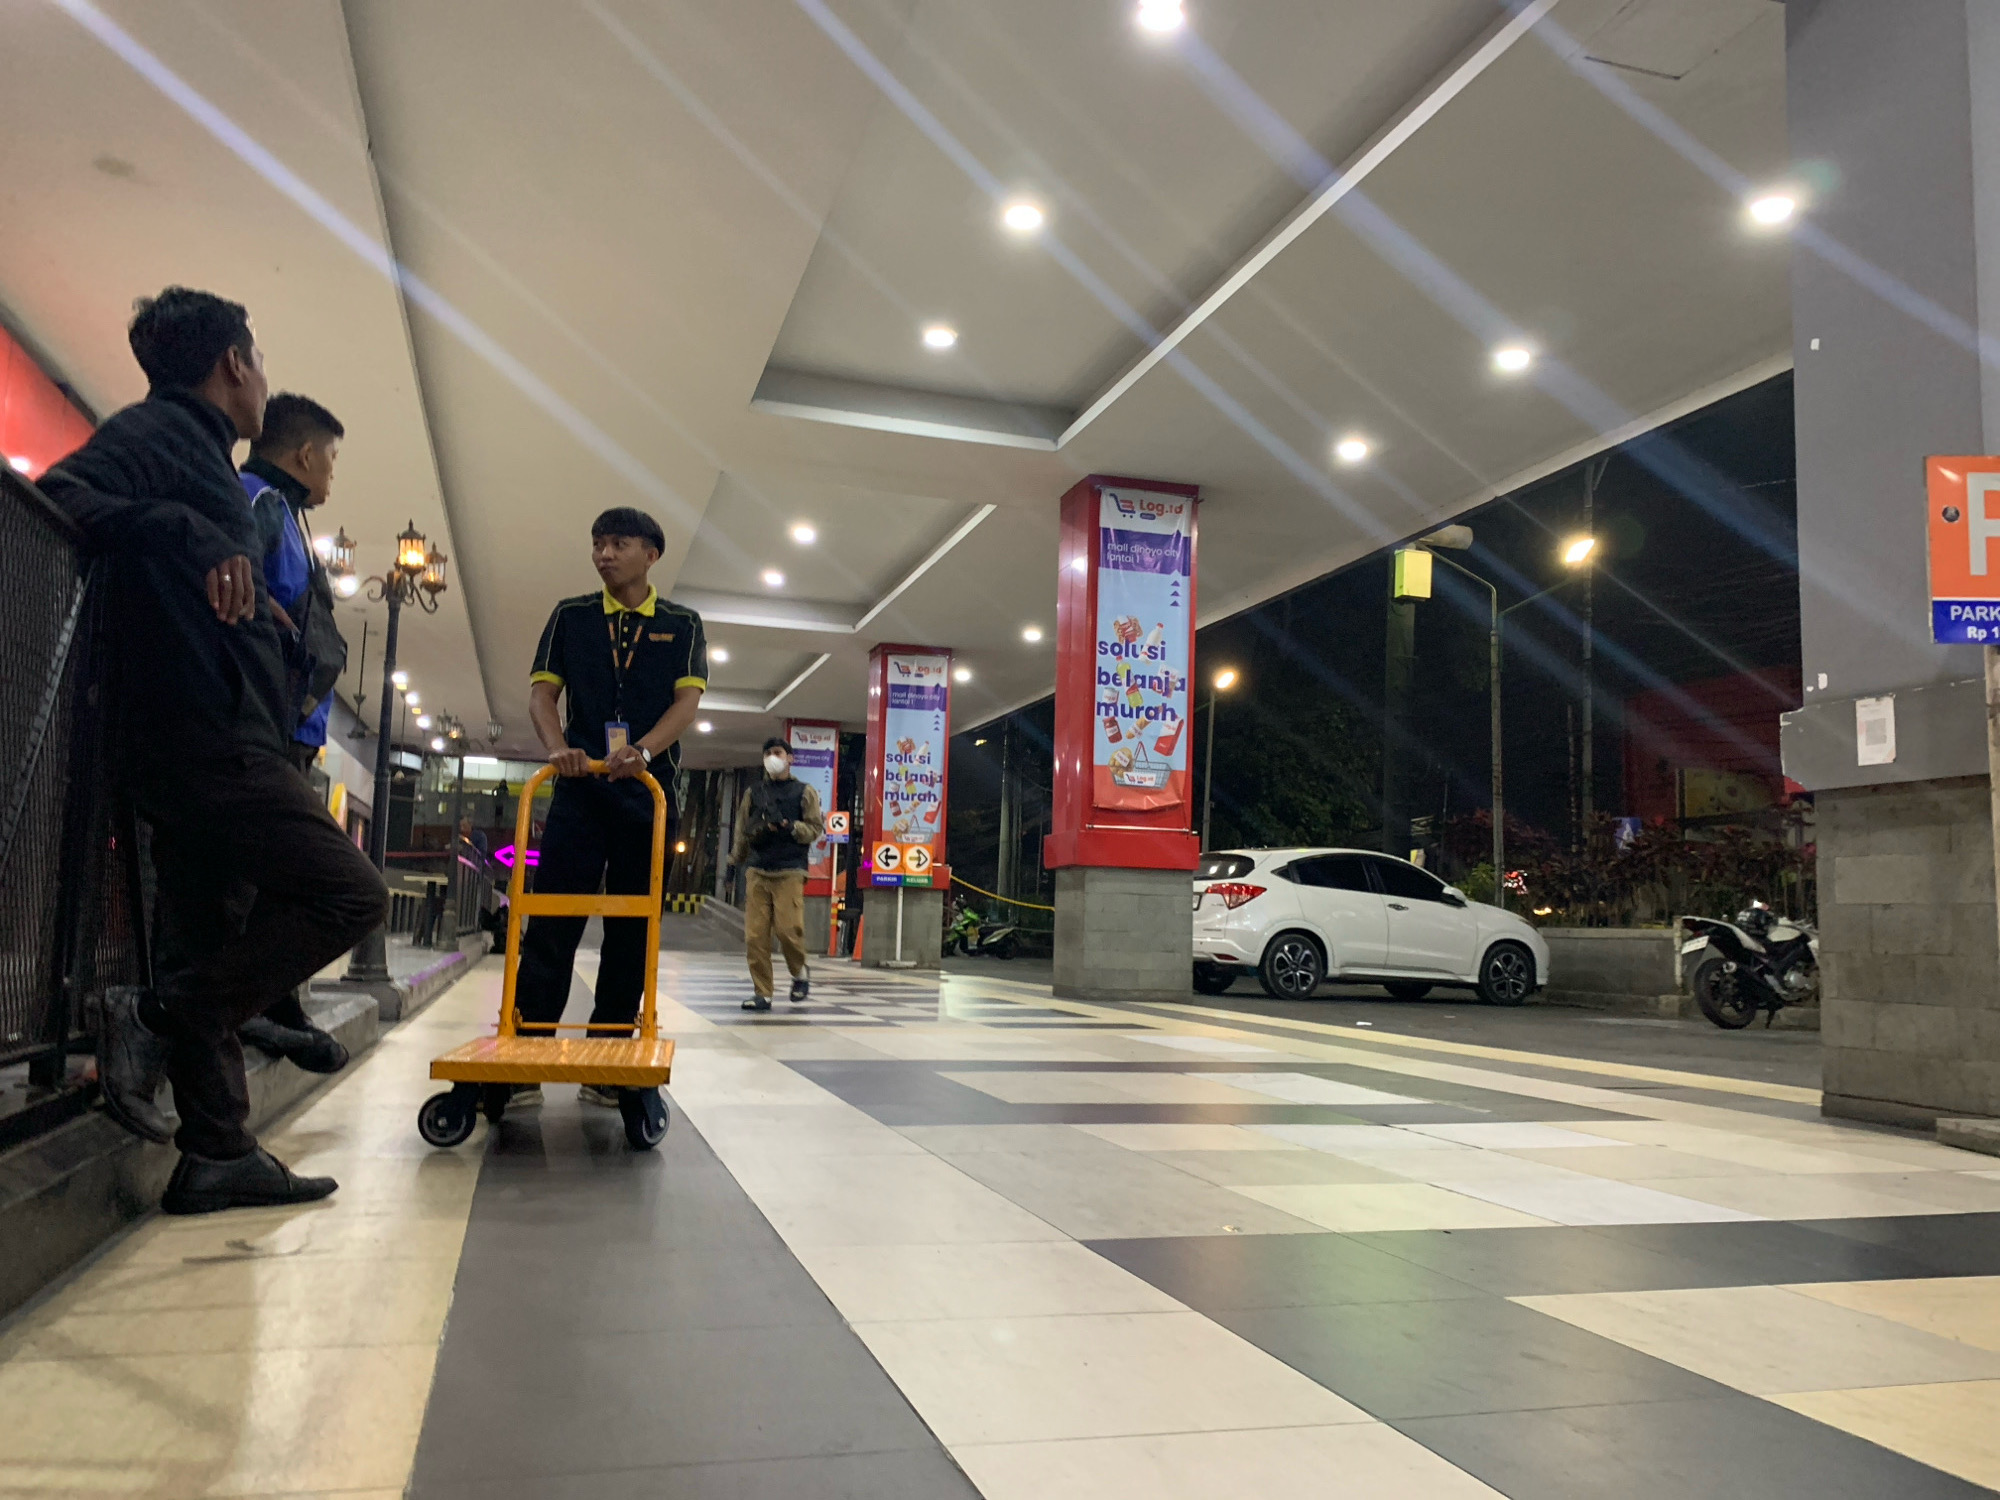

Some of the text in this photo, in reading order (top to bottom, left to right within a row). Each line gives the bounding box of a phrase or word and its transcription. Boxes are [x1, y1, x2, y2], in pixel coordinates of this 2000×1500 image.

[1140, 499, 1184, 517] Log.id
[1107, 543, 1182, 560] mall dinoyo city
[1107, 551, 1134, 563] lantai
[1967, 626, 1987, 641] Rp
[1098, 639, 1166, 660] solusi
[1097, 666, 1186, 697] belanja
[1096, 701, 1176, 721] murah
[886, 750, 932, 764] solusi
[886, 769, 943, 788] belanja
[885, 790, 938, 802] murah
